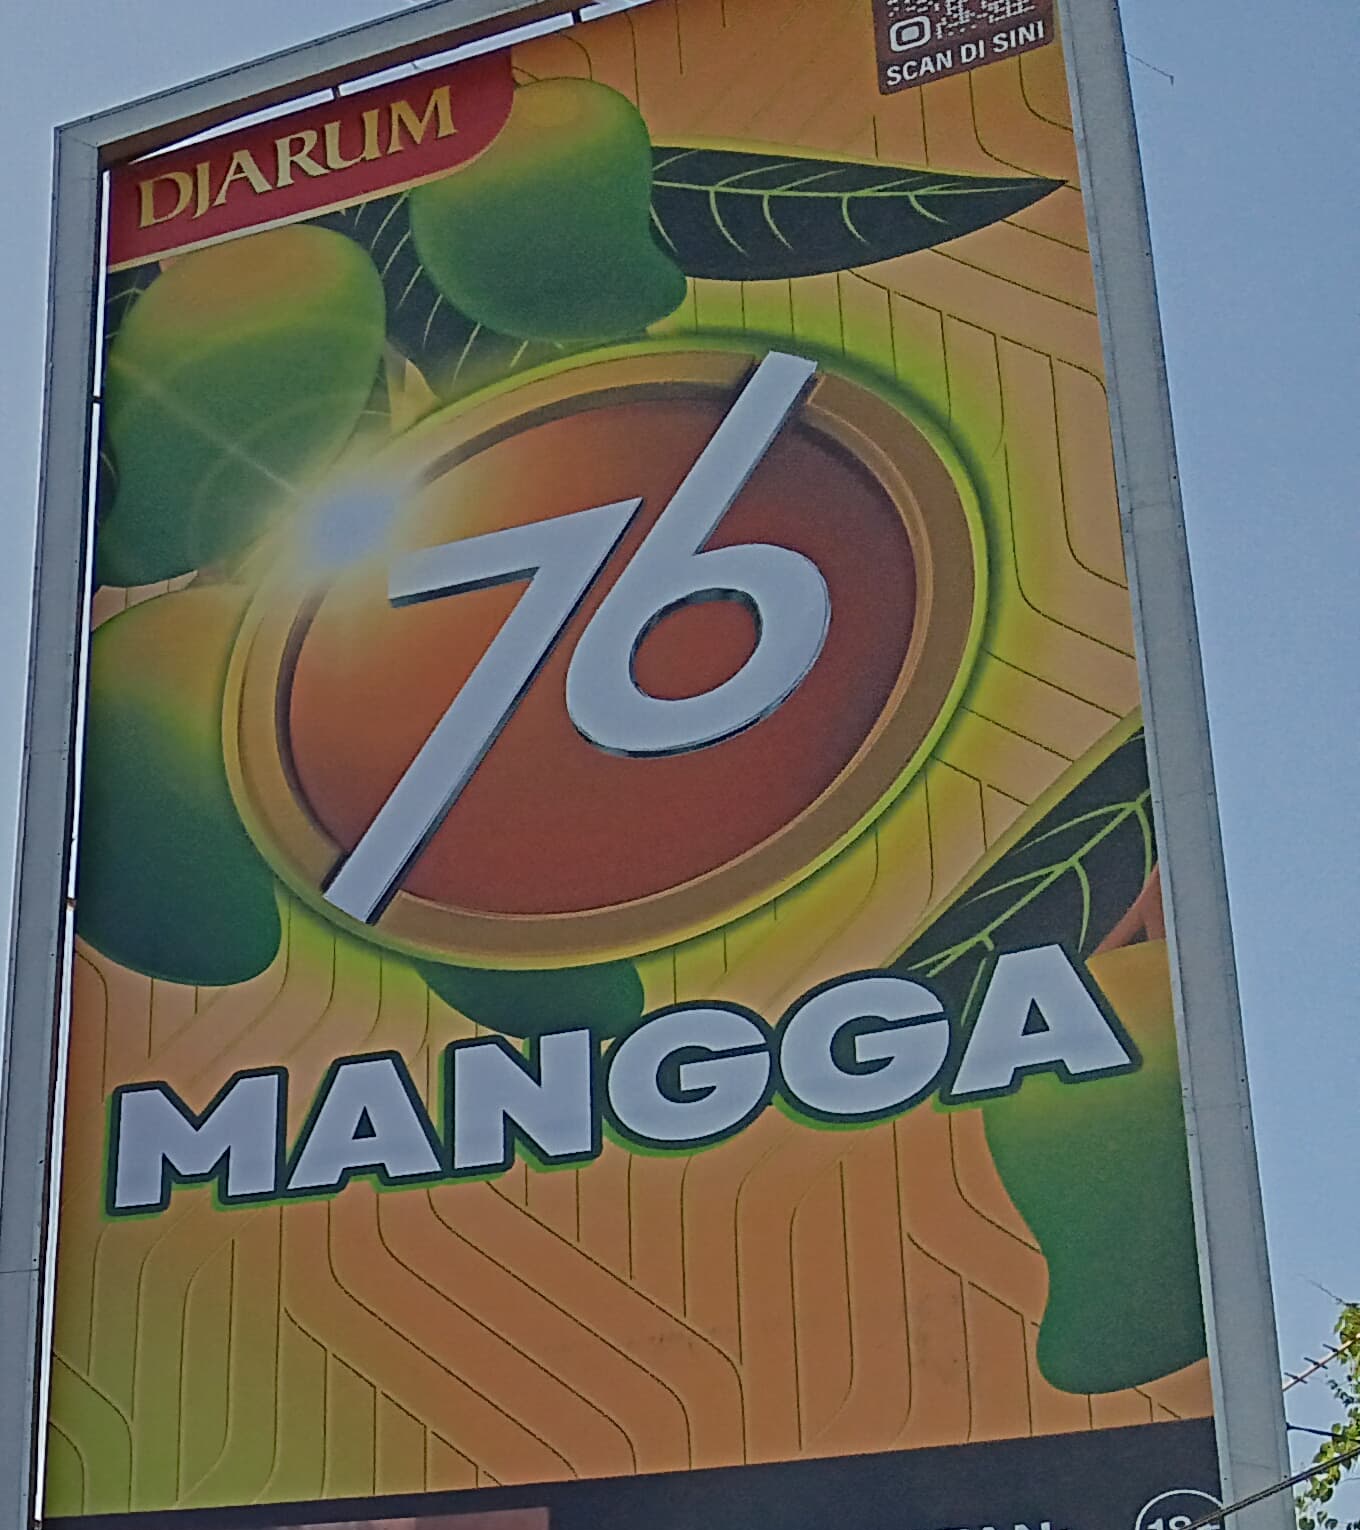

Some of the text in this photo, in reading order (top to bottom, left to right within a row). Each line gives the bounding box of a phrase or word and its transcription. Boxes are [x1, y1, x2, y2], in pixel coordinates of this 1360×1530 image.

[137, 85, 458, 229] DJARUM
[886, 20, 1045, 86] SCAN DI SINI
[323, 350, 832, 925] 76
[110, 941, 1136, 1213] MANGGA
